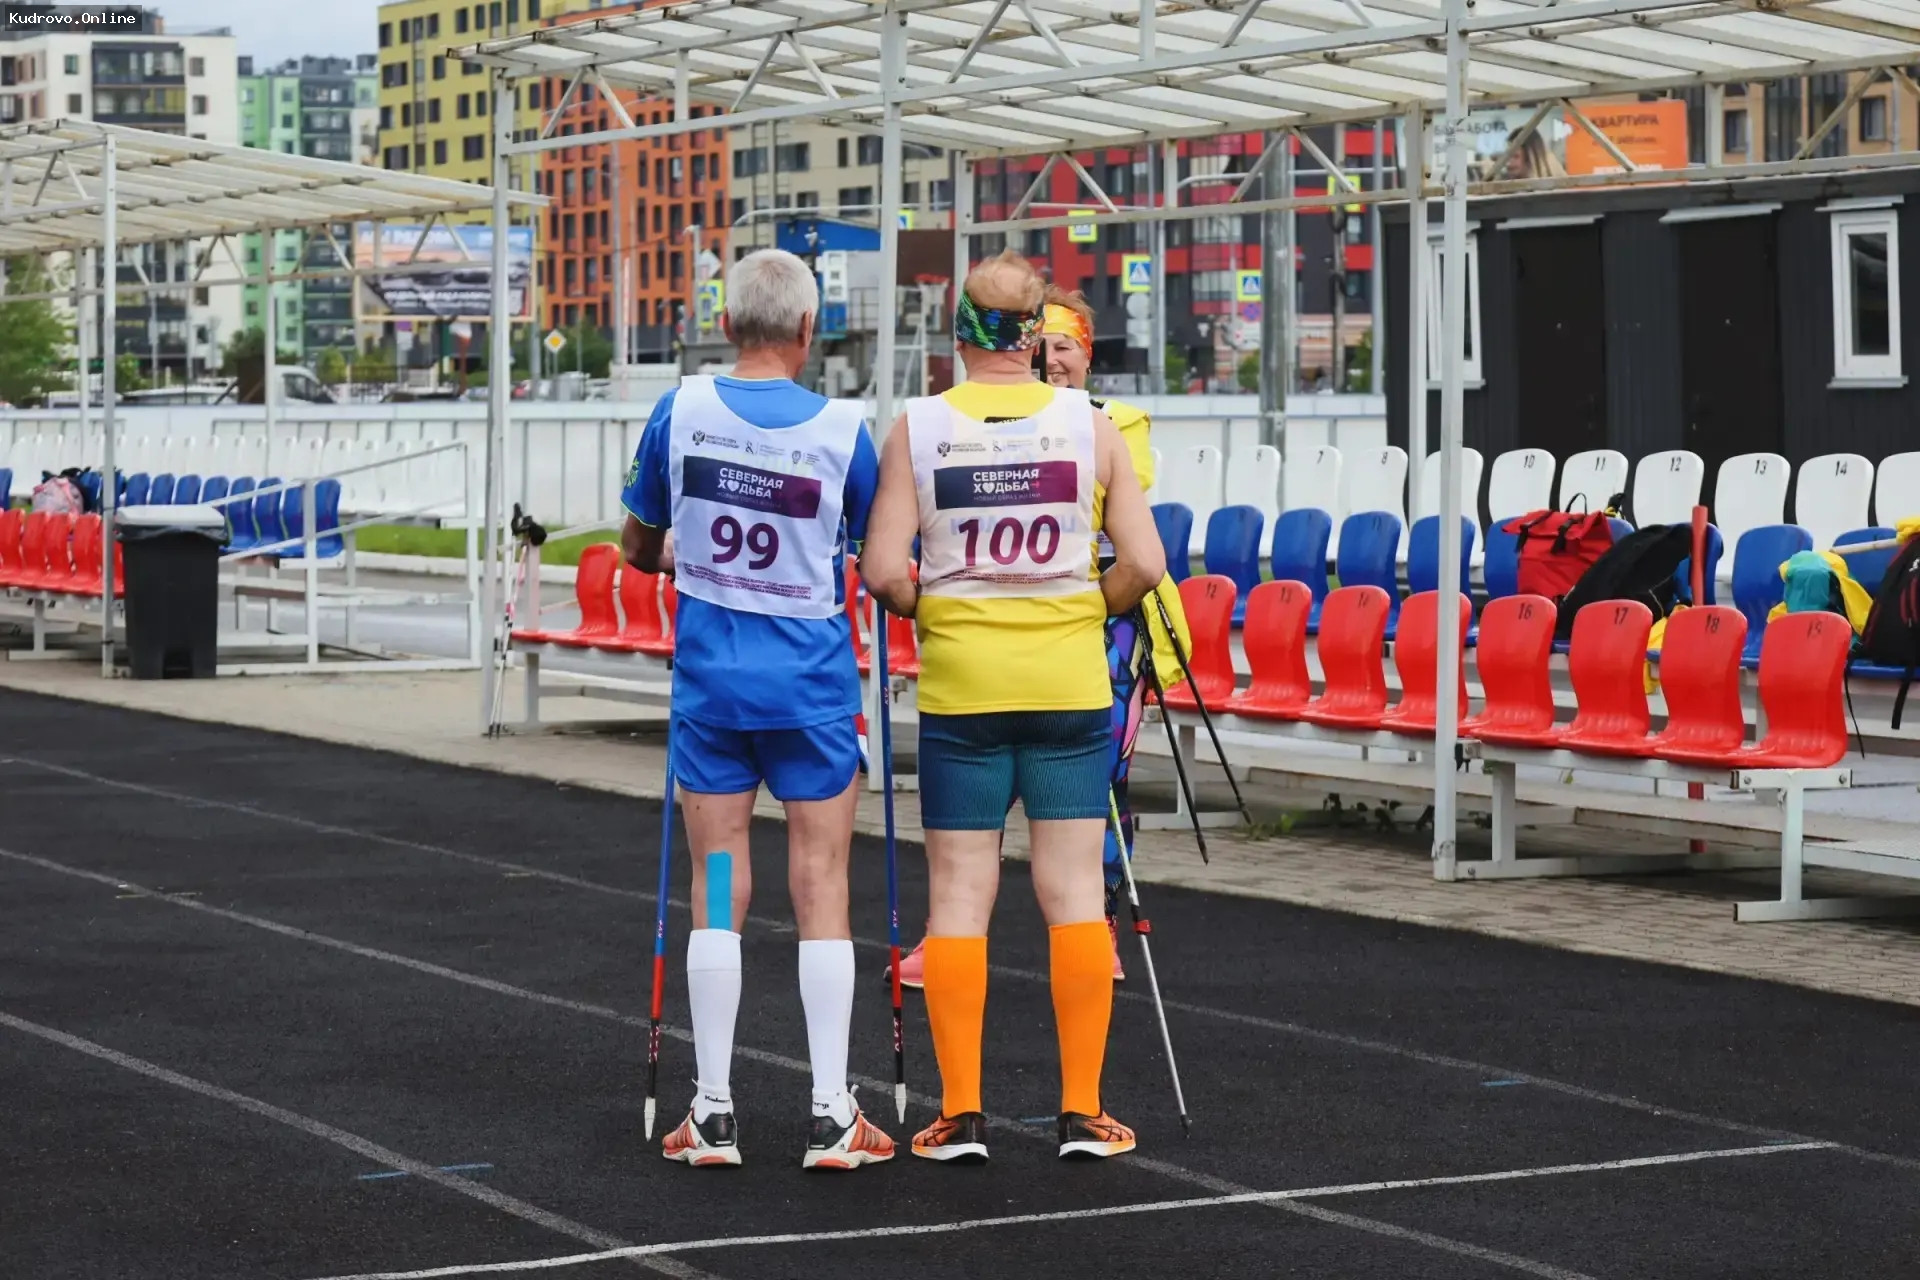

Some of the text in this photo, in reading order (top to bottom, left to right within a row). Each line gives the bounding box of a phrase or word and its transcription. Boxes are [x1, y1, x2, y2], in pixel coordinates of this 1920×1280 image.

[1317, 450, 1324, 464] 7
[1523, 454, 1535, 469] 10
[1594, 456, 1607, 471] 11
[1669, 456, 1682, 472] 12
[972, 468, 1040, 482] СЕВЕРНАЯ
[1754, 459, 1768, 475] 13
[1835, 460, 1848, 477] 14
[719, 467, 784, 490] СЕВЕРНАЯ
[710, 515, 779, 570] 99
[958, 514, 1061, 567] 100
[1205, 582, 1217, 600] 12
[1518, 603, 1532, 620] 16
[1613, 606, 1629, 625] 17
[1705, 613, 1720, 634] 18
